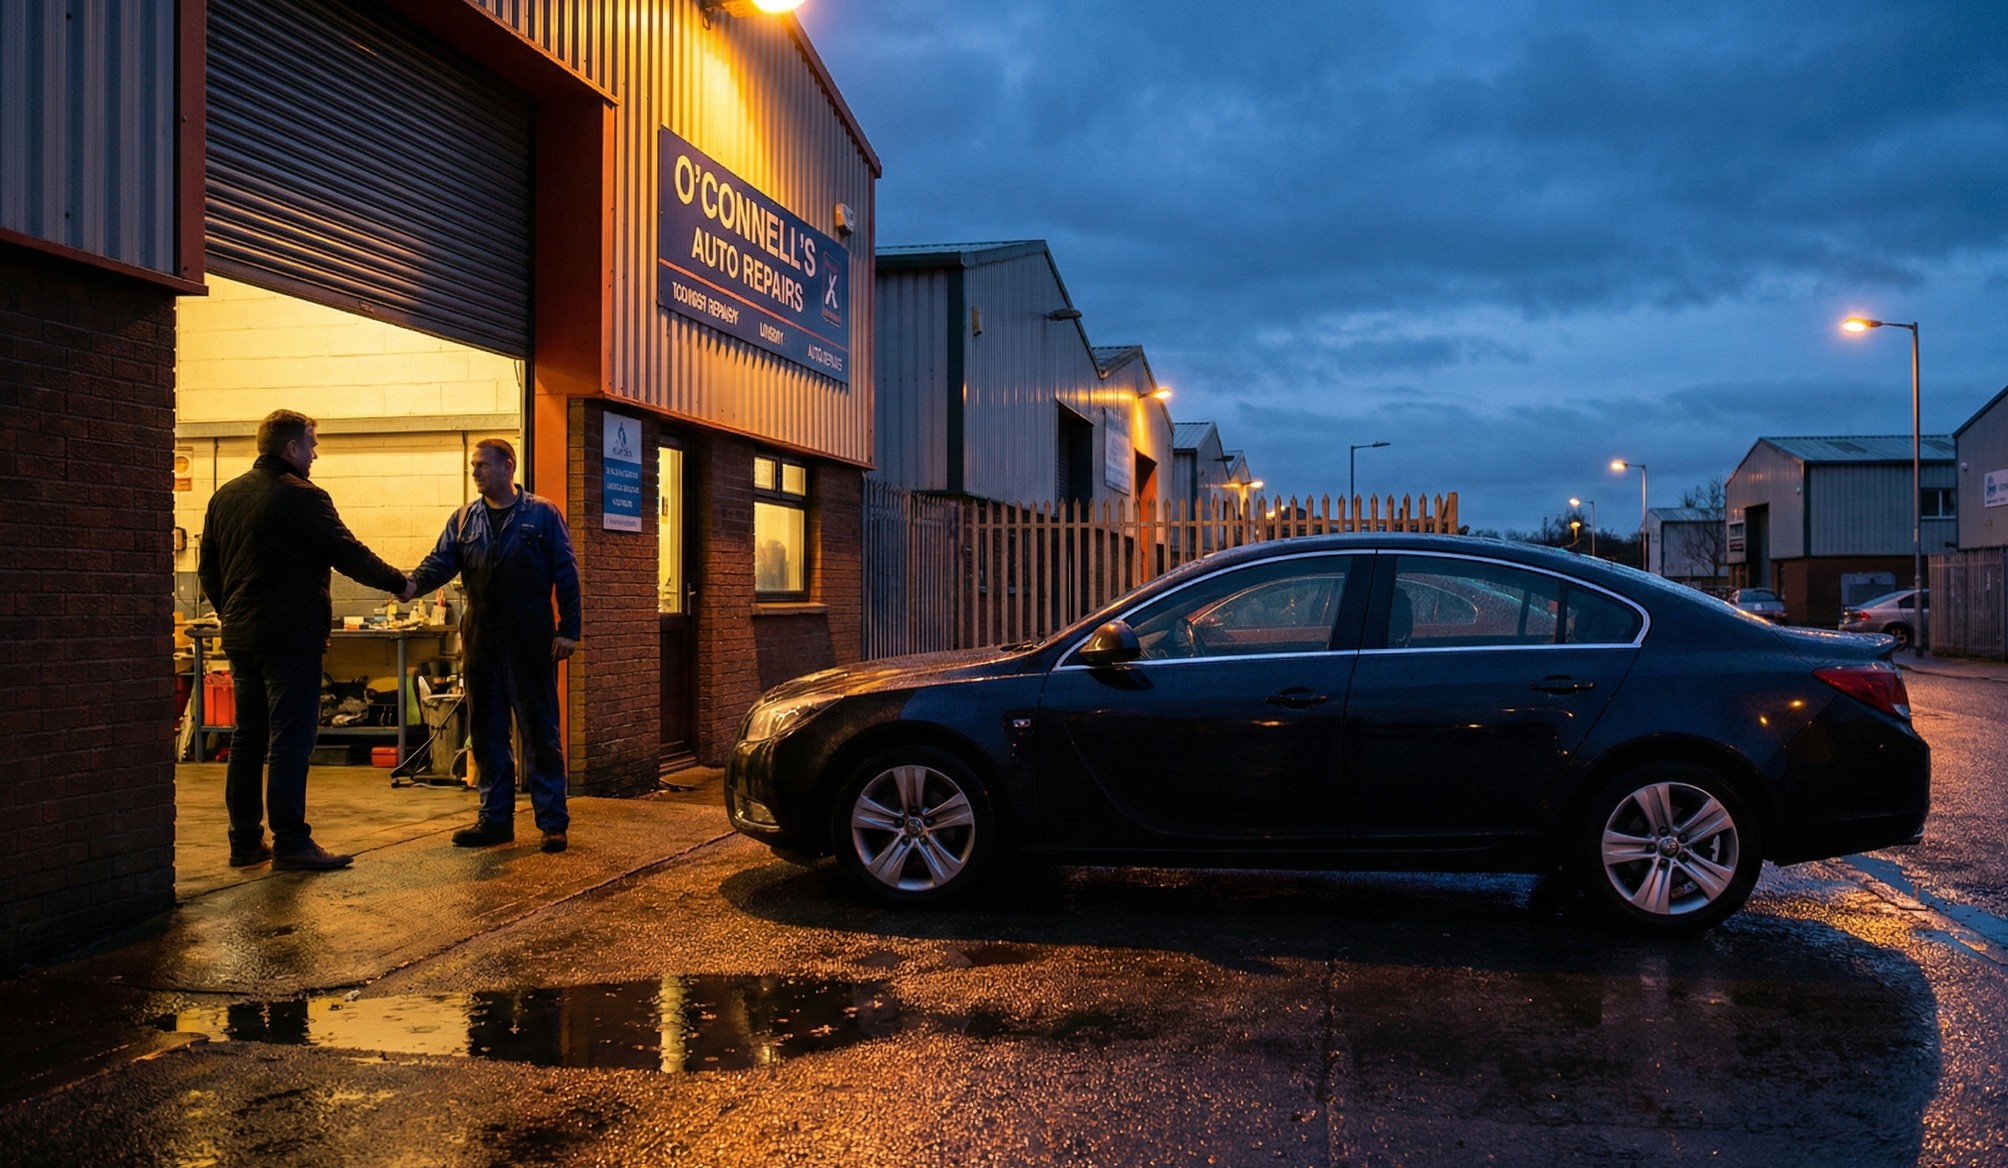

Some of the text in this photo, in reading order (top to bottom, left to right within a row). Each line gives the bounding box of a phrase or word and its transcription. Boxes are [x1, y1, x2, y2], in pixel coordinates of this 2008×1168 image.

[674, 154, 816, 278] O'CONNELL'S
[691, 227, 803, 313] AUTO REPAIRS
